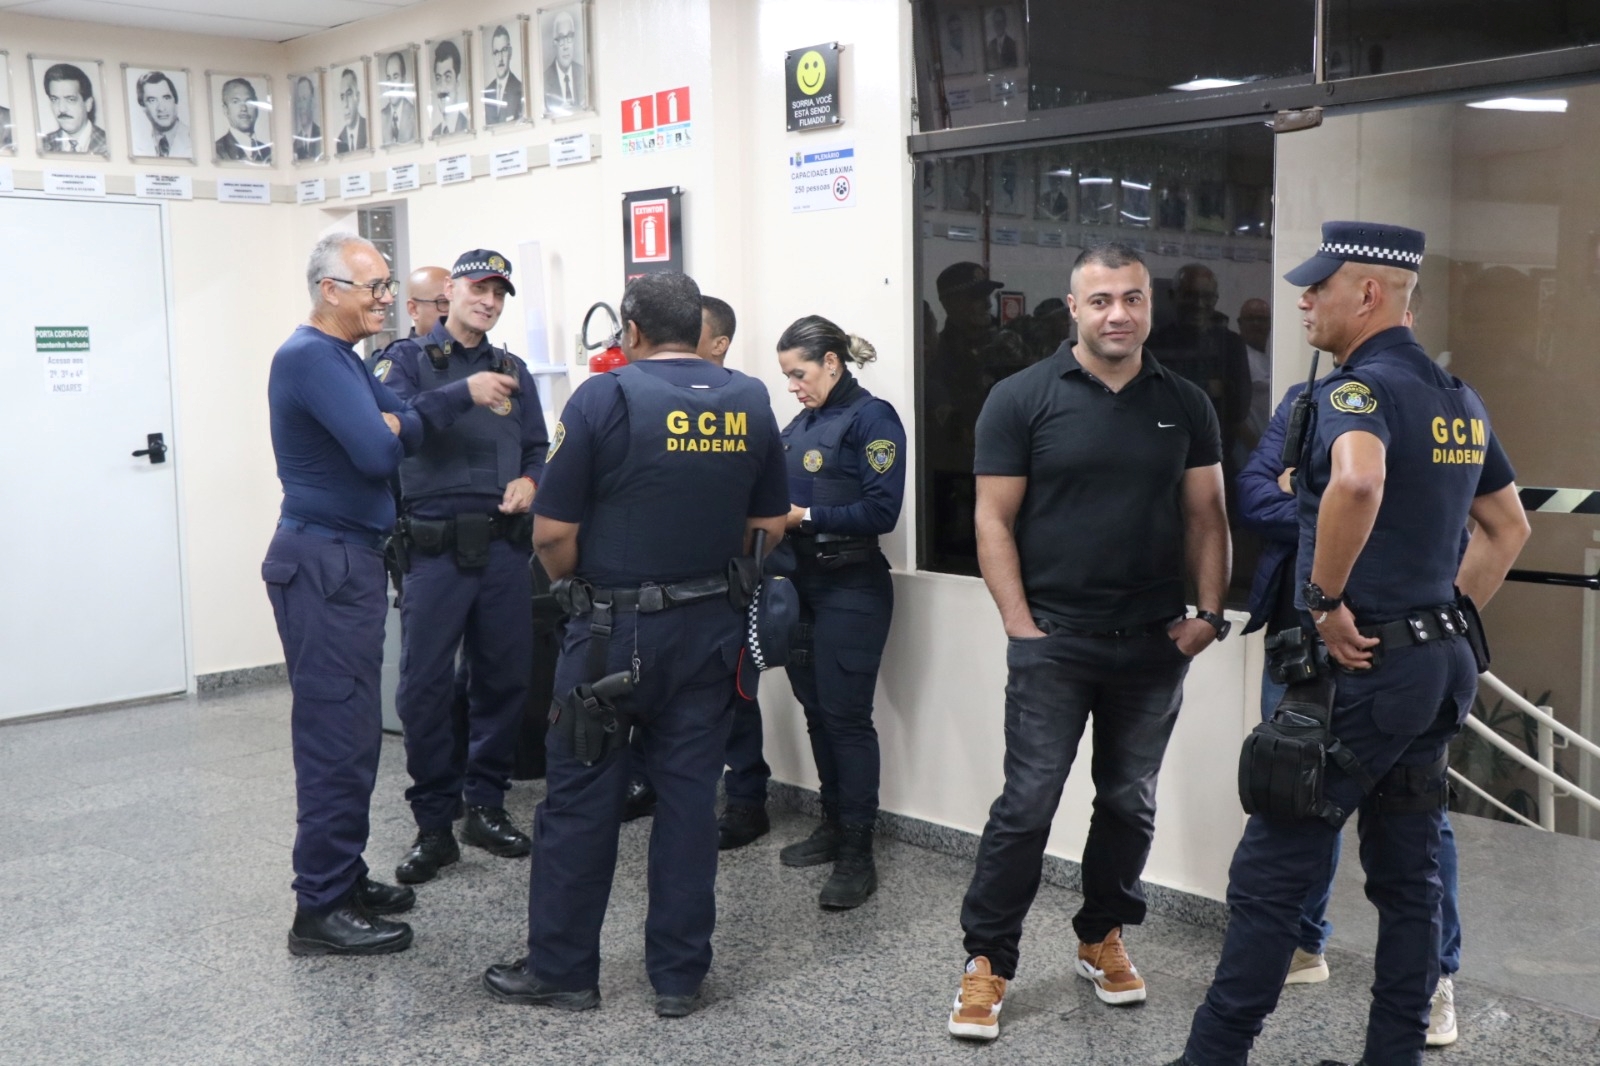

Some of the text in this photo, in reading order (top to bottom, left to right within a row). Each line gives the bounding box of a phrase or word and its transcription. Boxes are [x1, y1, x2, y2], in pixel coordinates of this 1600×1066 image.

[792, 93, 832, 109] SORRIA, VOCÊ
[794, 105, 831, 118] ESTÁ SENDO
[799, 115, 826, 127] FILMADO!
[815, 152, 839, 161] PLENÁRIO
[791, 165, 854, 180] CAPACIDADE MÁXIMA
[806, 184, 831, 194] pessoas
[635, 205, 664, 215] EXTINTOR
[36, 330, 88, 338] PORTA CORTA-FOGO
[53, 384, 82, 392] ANDARES
[666, 437, 747, 452] DIADEMA
